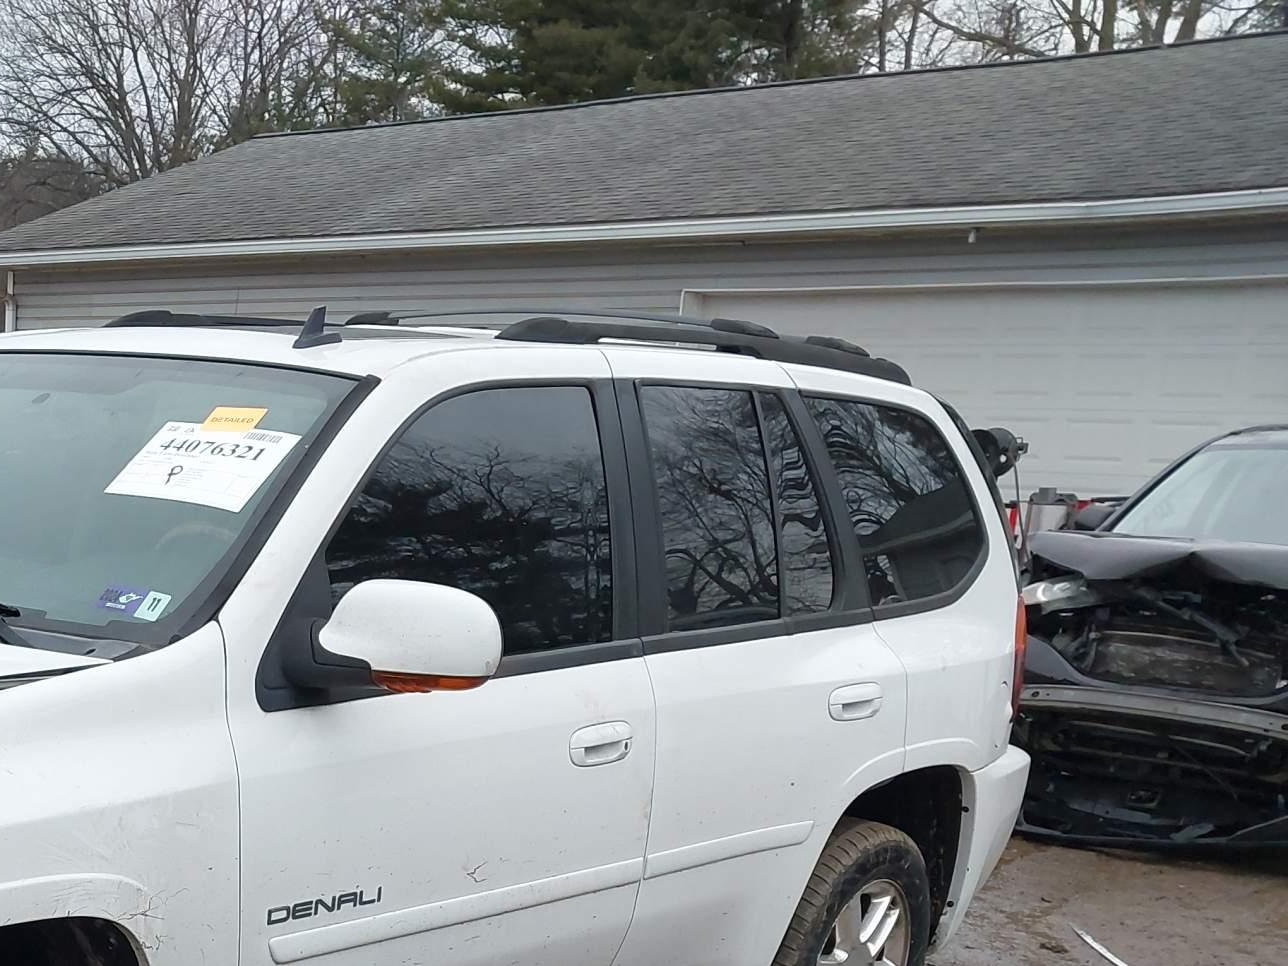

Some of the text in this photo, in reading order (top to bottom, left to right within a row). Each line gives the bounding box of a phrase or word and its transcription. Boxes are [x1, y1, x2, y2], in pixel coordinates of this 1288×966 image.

[210, 416, 255, 424] DETAILED
[160, 438, 266, 461] 44076321
[147, 597, 162, 613] 11
[267, 886, 383, 926] DENALI
